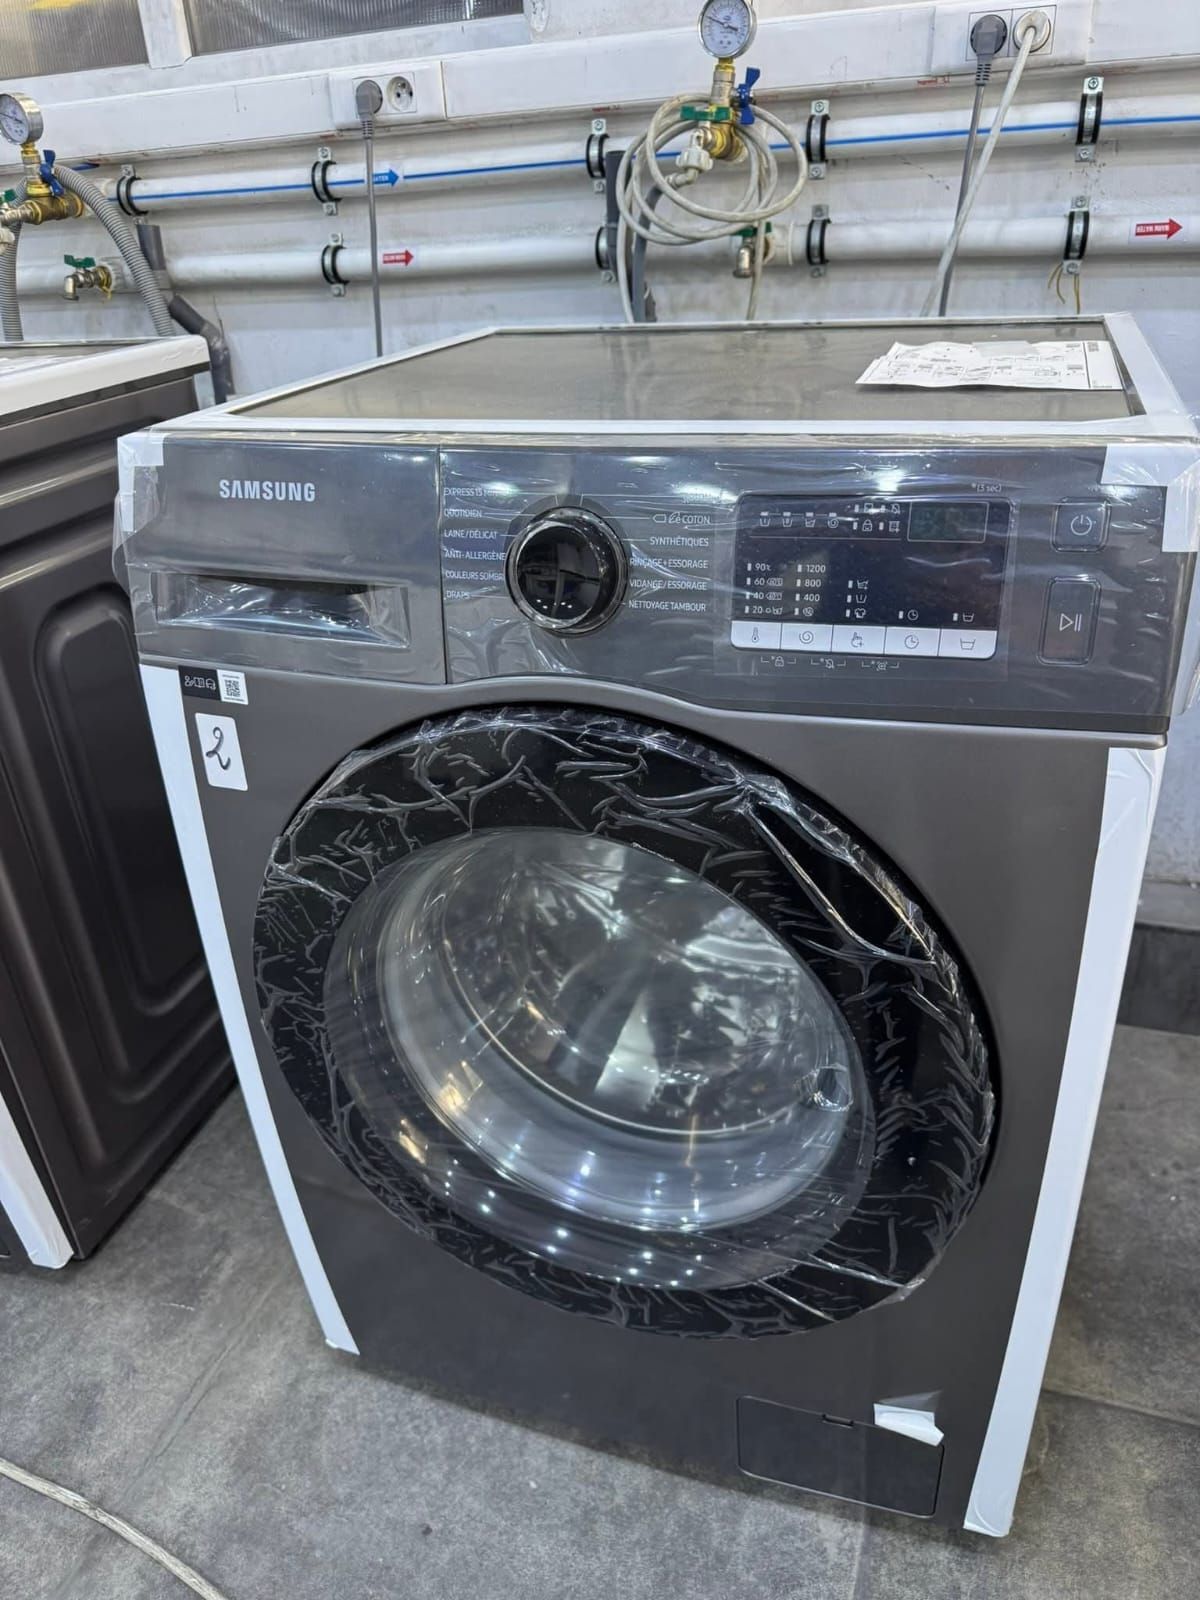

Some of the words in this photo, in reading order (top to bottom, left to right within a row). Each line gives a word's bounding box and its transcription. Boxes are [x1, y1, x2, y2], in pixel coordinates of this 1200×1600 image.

[218, 479, 317, 504] SAMSUNG
[682, 514, 711, 525] COTON
[649, 535, 710, 548] SYNTHÉTIQUES
[805, 564, 826, 574] 1200
[445, 569, 479, 580] COULEURS
[753, 577, 766, 587] 60
[804, 578, 822, 588] 800
[446, 590, 470, 600] DRAPS
[803, 593, 821, 603] 400
[628, 599, 670, 611] NETTOYAGE
[670, 602, 707, 613] TAMBOUR
[752, 605, 764, 614] 20
[205, 725, 232, 772] 2
